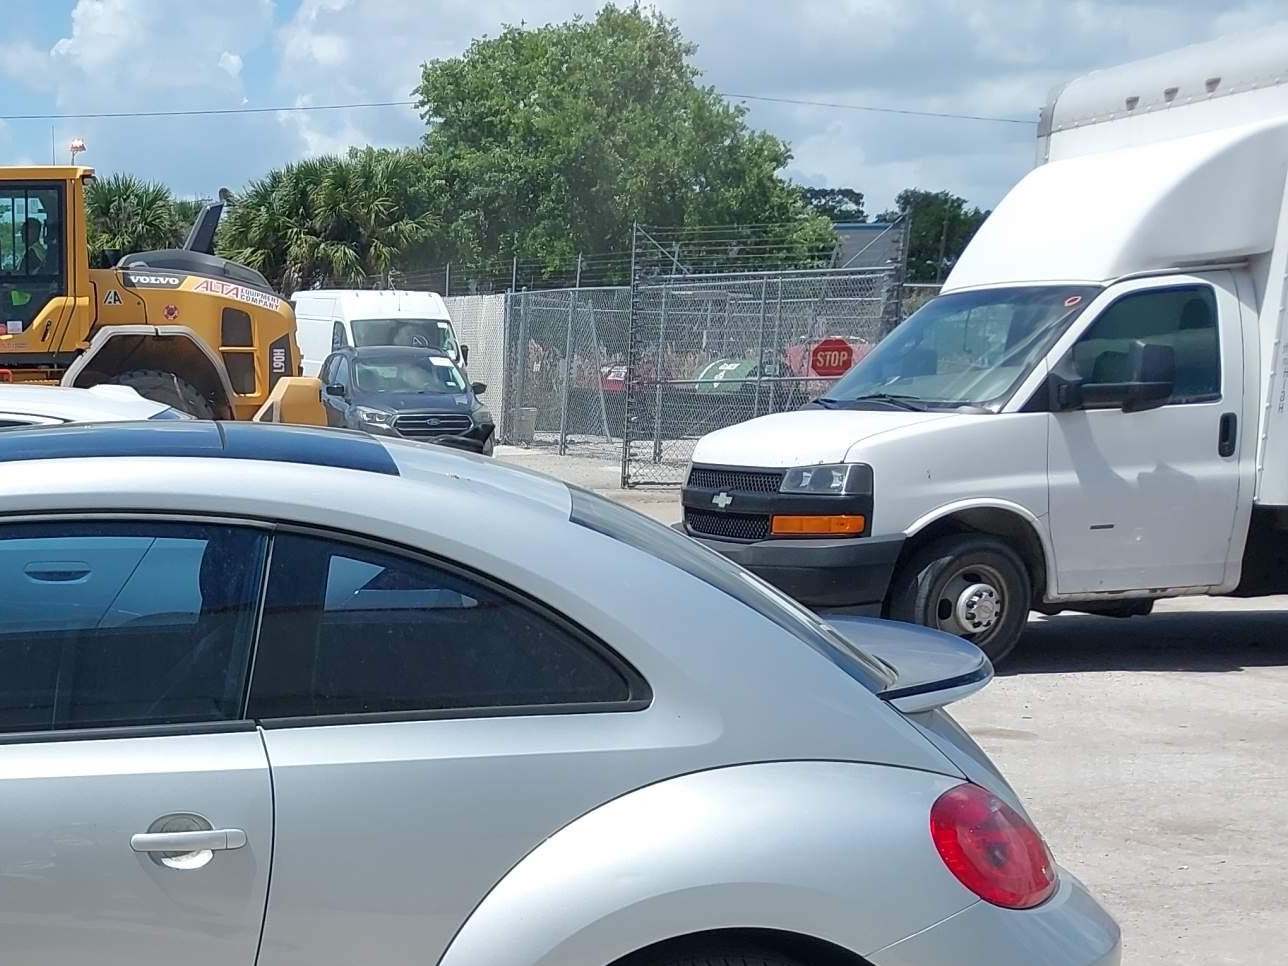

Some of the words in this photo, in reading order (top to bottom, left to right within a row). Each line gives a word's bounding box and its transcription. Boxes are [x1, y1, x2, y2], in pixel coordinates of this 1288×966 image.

[129, 275, 180, 285] VOLVO
[194, 279, 240, 299] ALTA
[240, 294, 281, 311] COMPANY
[241, 283, 281, 304] EQUIPMENT
[272, 348, 286, 373] L90H
[816, 350, 849, 368] STOP
